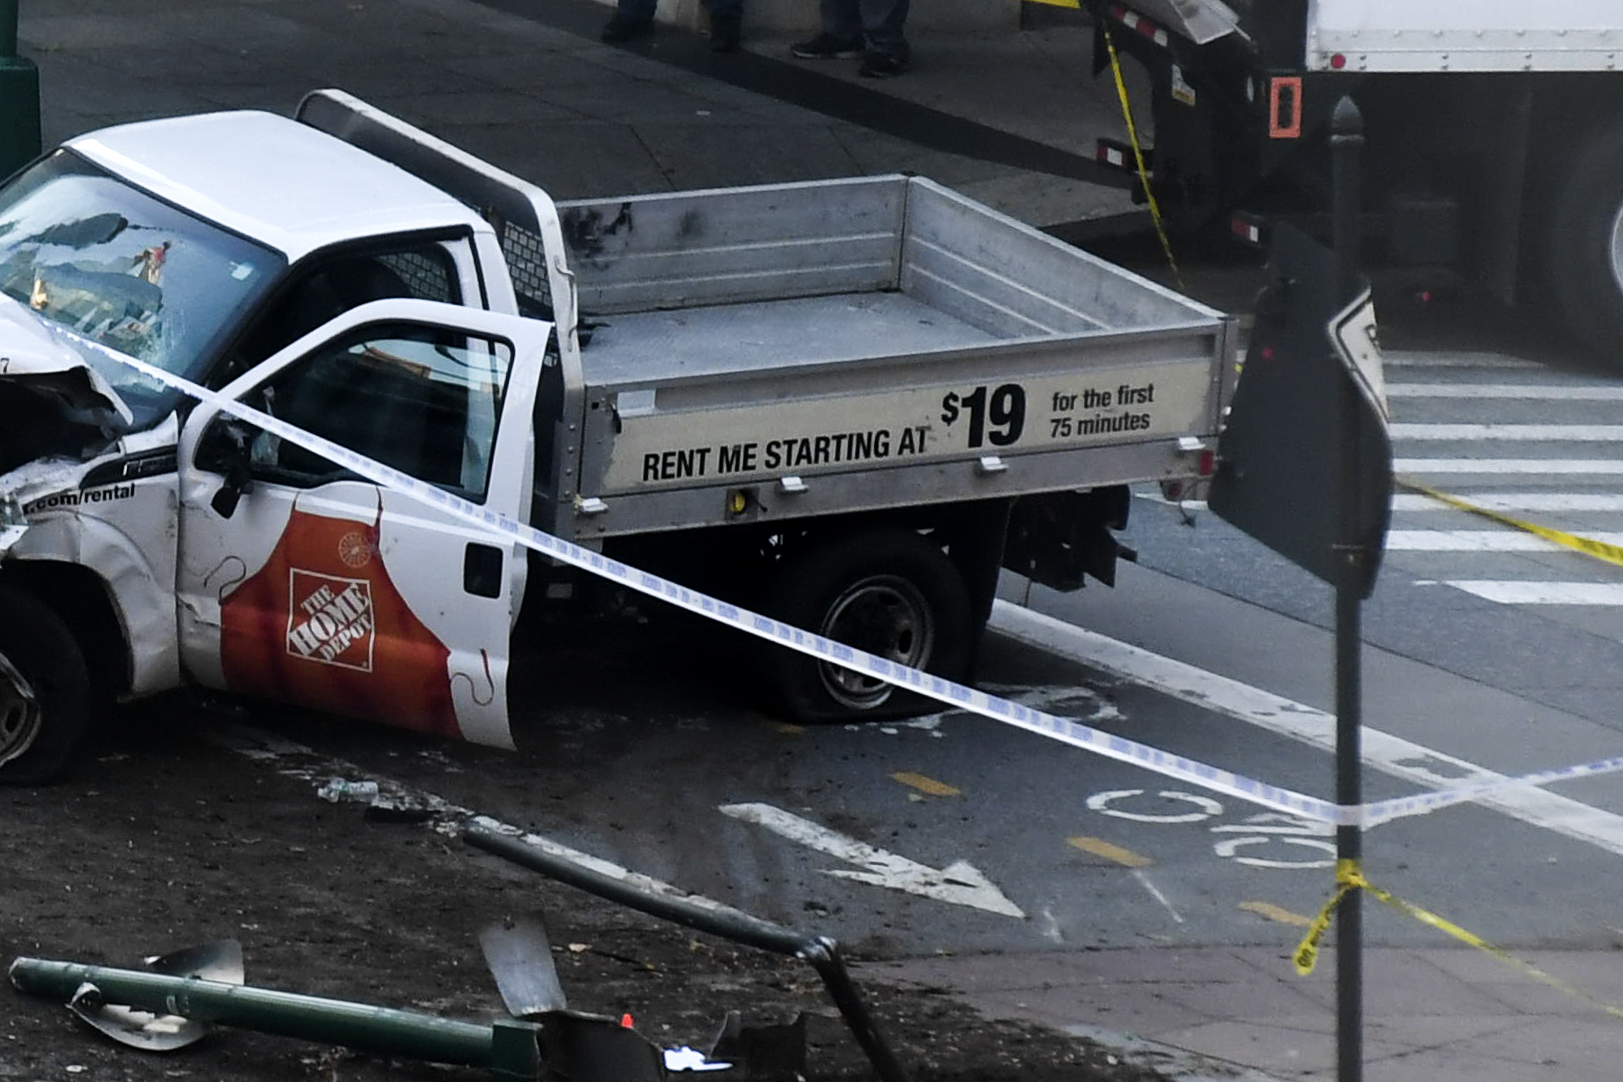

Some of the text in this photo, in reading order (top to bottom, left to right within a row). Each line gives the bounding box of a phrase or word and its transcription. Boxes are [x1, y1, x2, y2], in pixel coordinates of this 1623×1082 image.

[1052, 383, 1154, 411] for the first
[642, 383, 1026, 481] RENT ME STARTING AT $19
[1050, 411, 1150, 438] 75 minutes
[288, 582, 369, 657] HOME
[300, 584, 335, 616] THE
[319, 613, 373, 662] DEPOT
